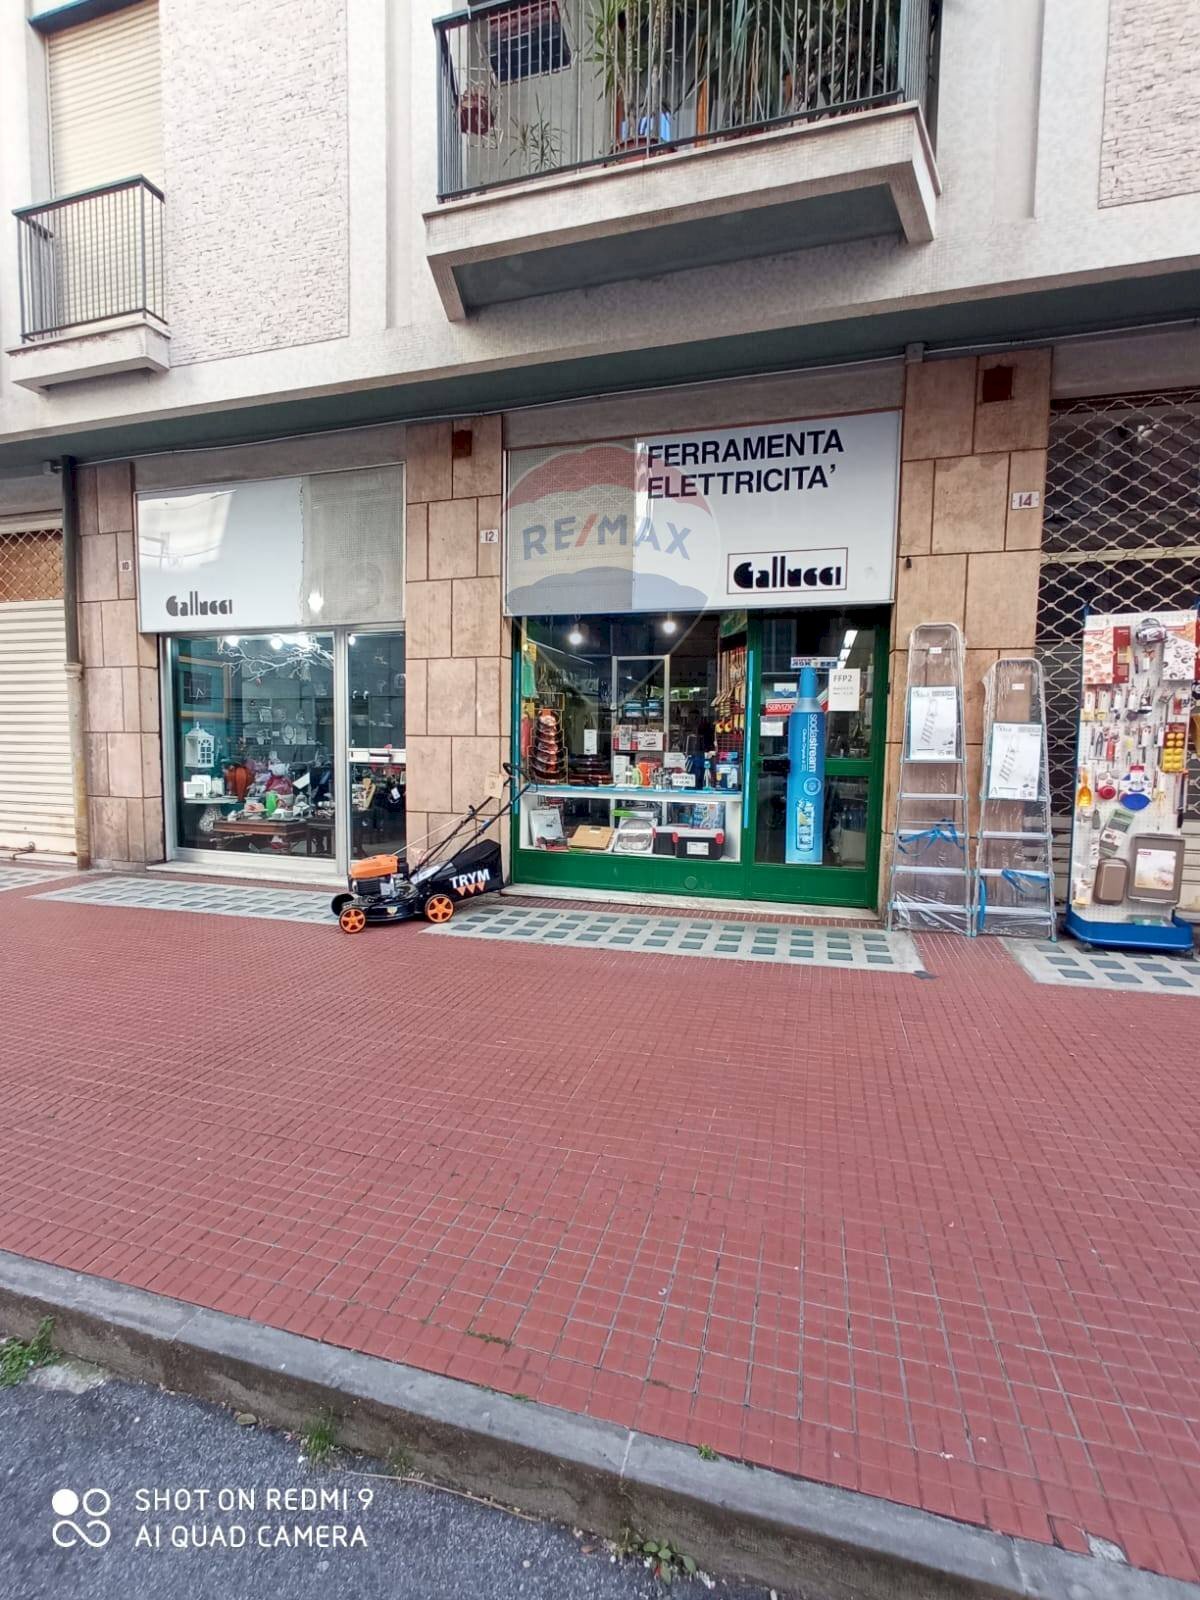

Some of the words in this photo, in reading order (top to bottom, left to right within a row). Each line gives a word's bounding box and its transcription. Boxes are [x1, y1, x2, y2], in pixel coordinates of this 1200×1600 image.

[648, 428, 844, 468] FERRAMENTA
[1018, 493, 1033, 507] 14
[485, 530, 495, 542] 12
[733, 555, 842, 590] Gallucci
[166, 590, 233, 617] Gallucci
[833, 674, 853, 682] FFP2
[808, 714, 820, 772] sodastream
[449, 867, 491, 890] TRYM
